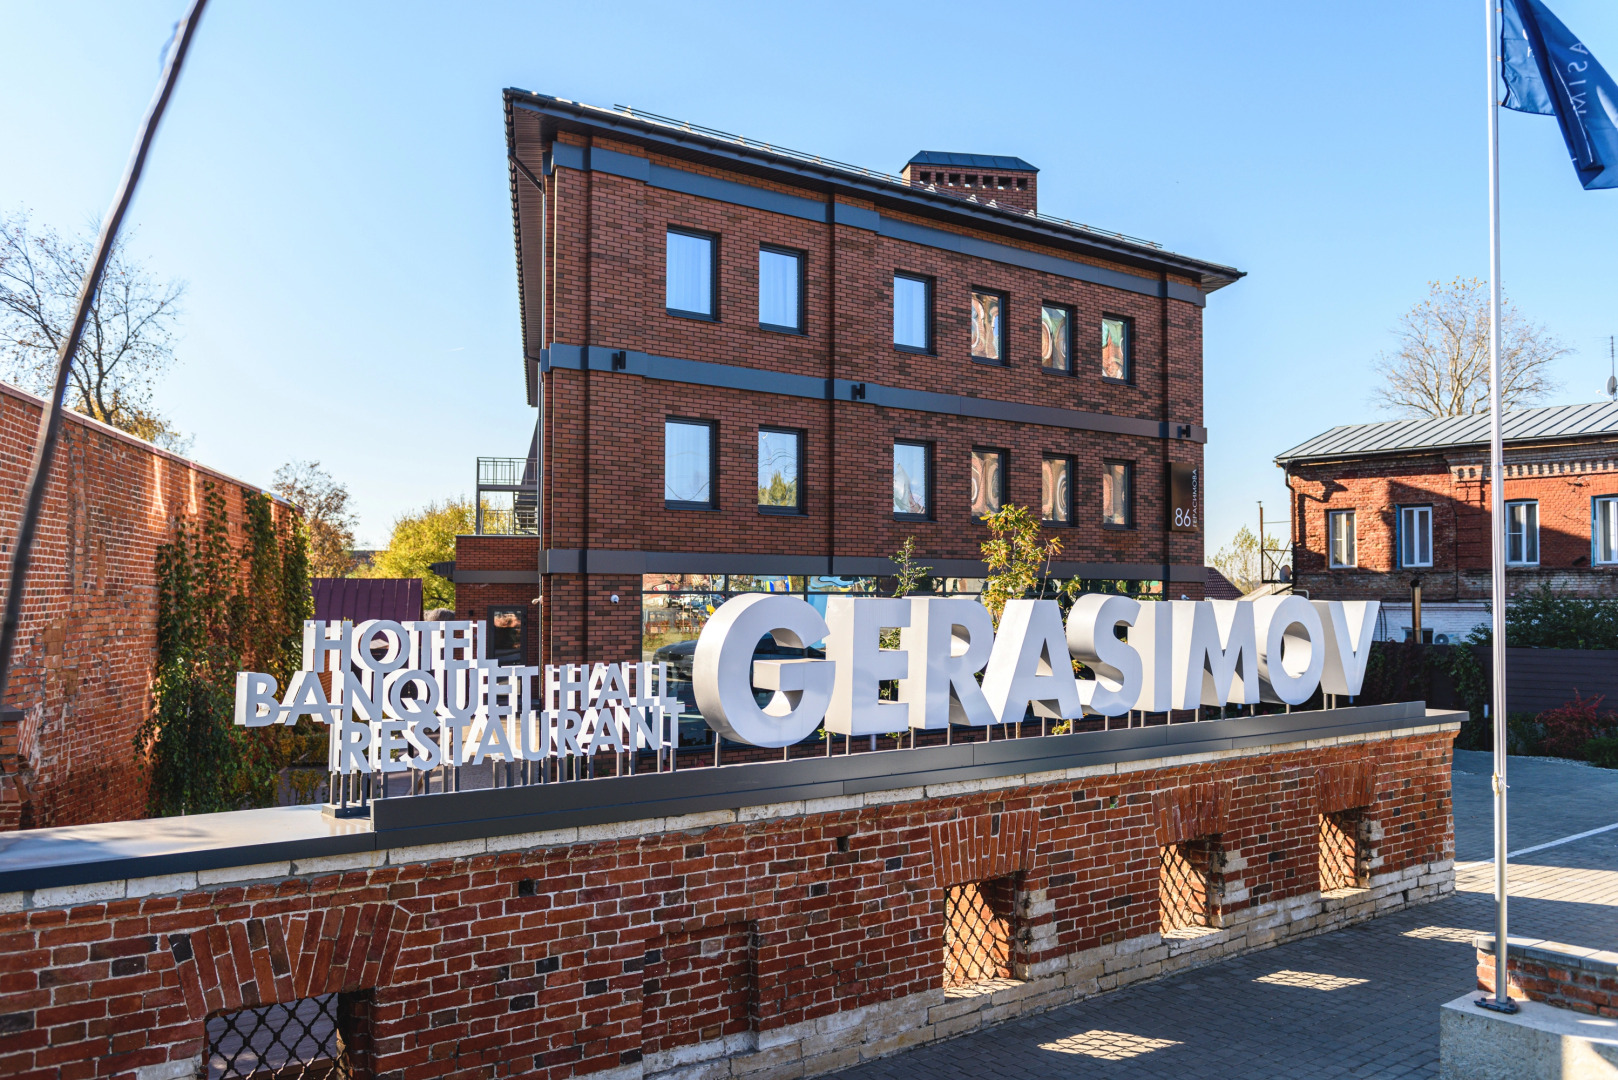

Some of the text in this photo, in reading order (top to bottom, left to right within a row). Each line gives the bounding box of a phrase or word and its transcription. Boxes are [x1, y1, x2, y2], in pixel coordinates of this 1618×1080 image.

[1174, 507, 1192, 527] 86
[303, 619, 499, 673] HOTEL
[692, 592, 1381, 749] GERASIMOV
[235, 661, 683, 728] BANQUET HALL
[329, 703, 686, 774] RESTAURANT
